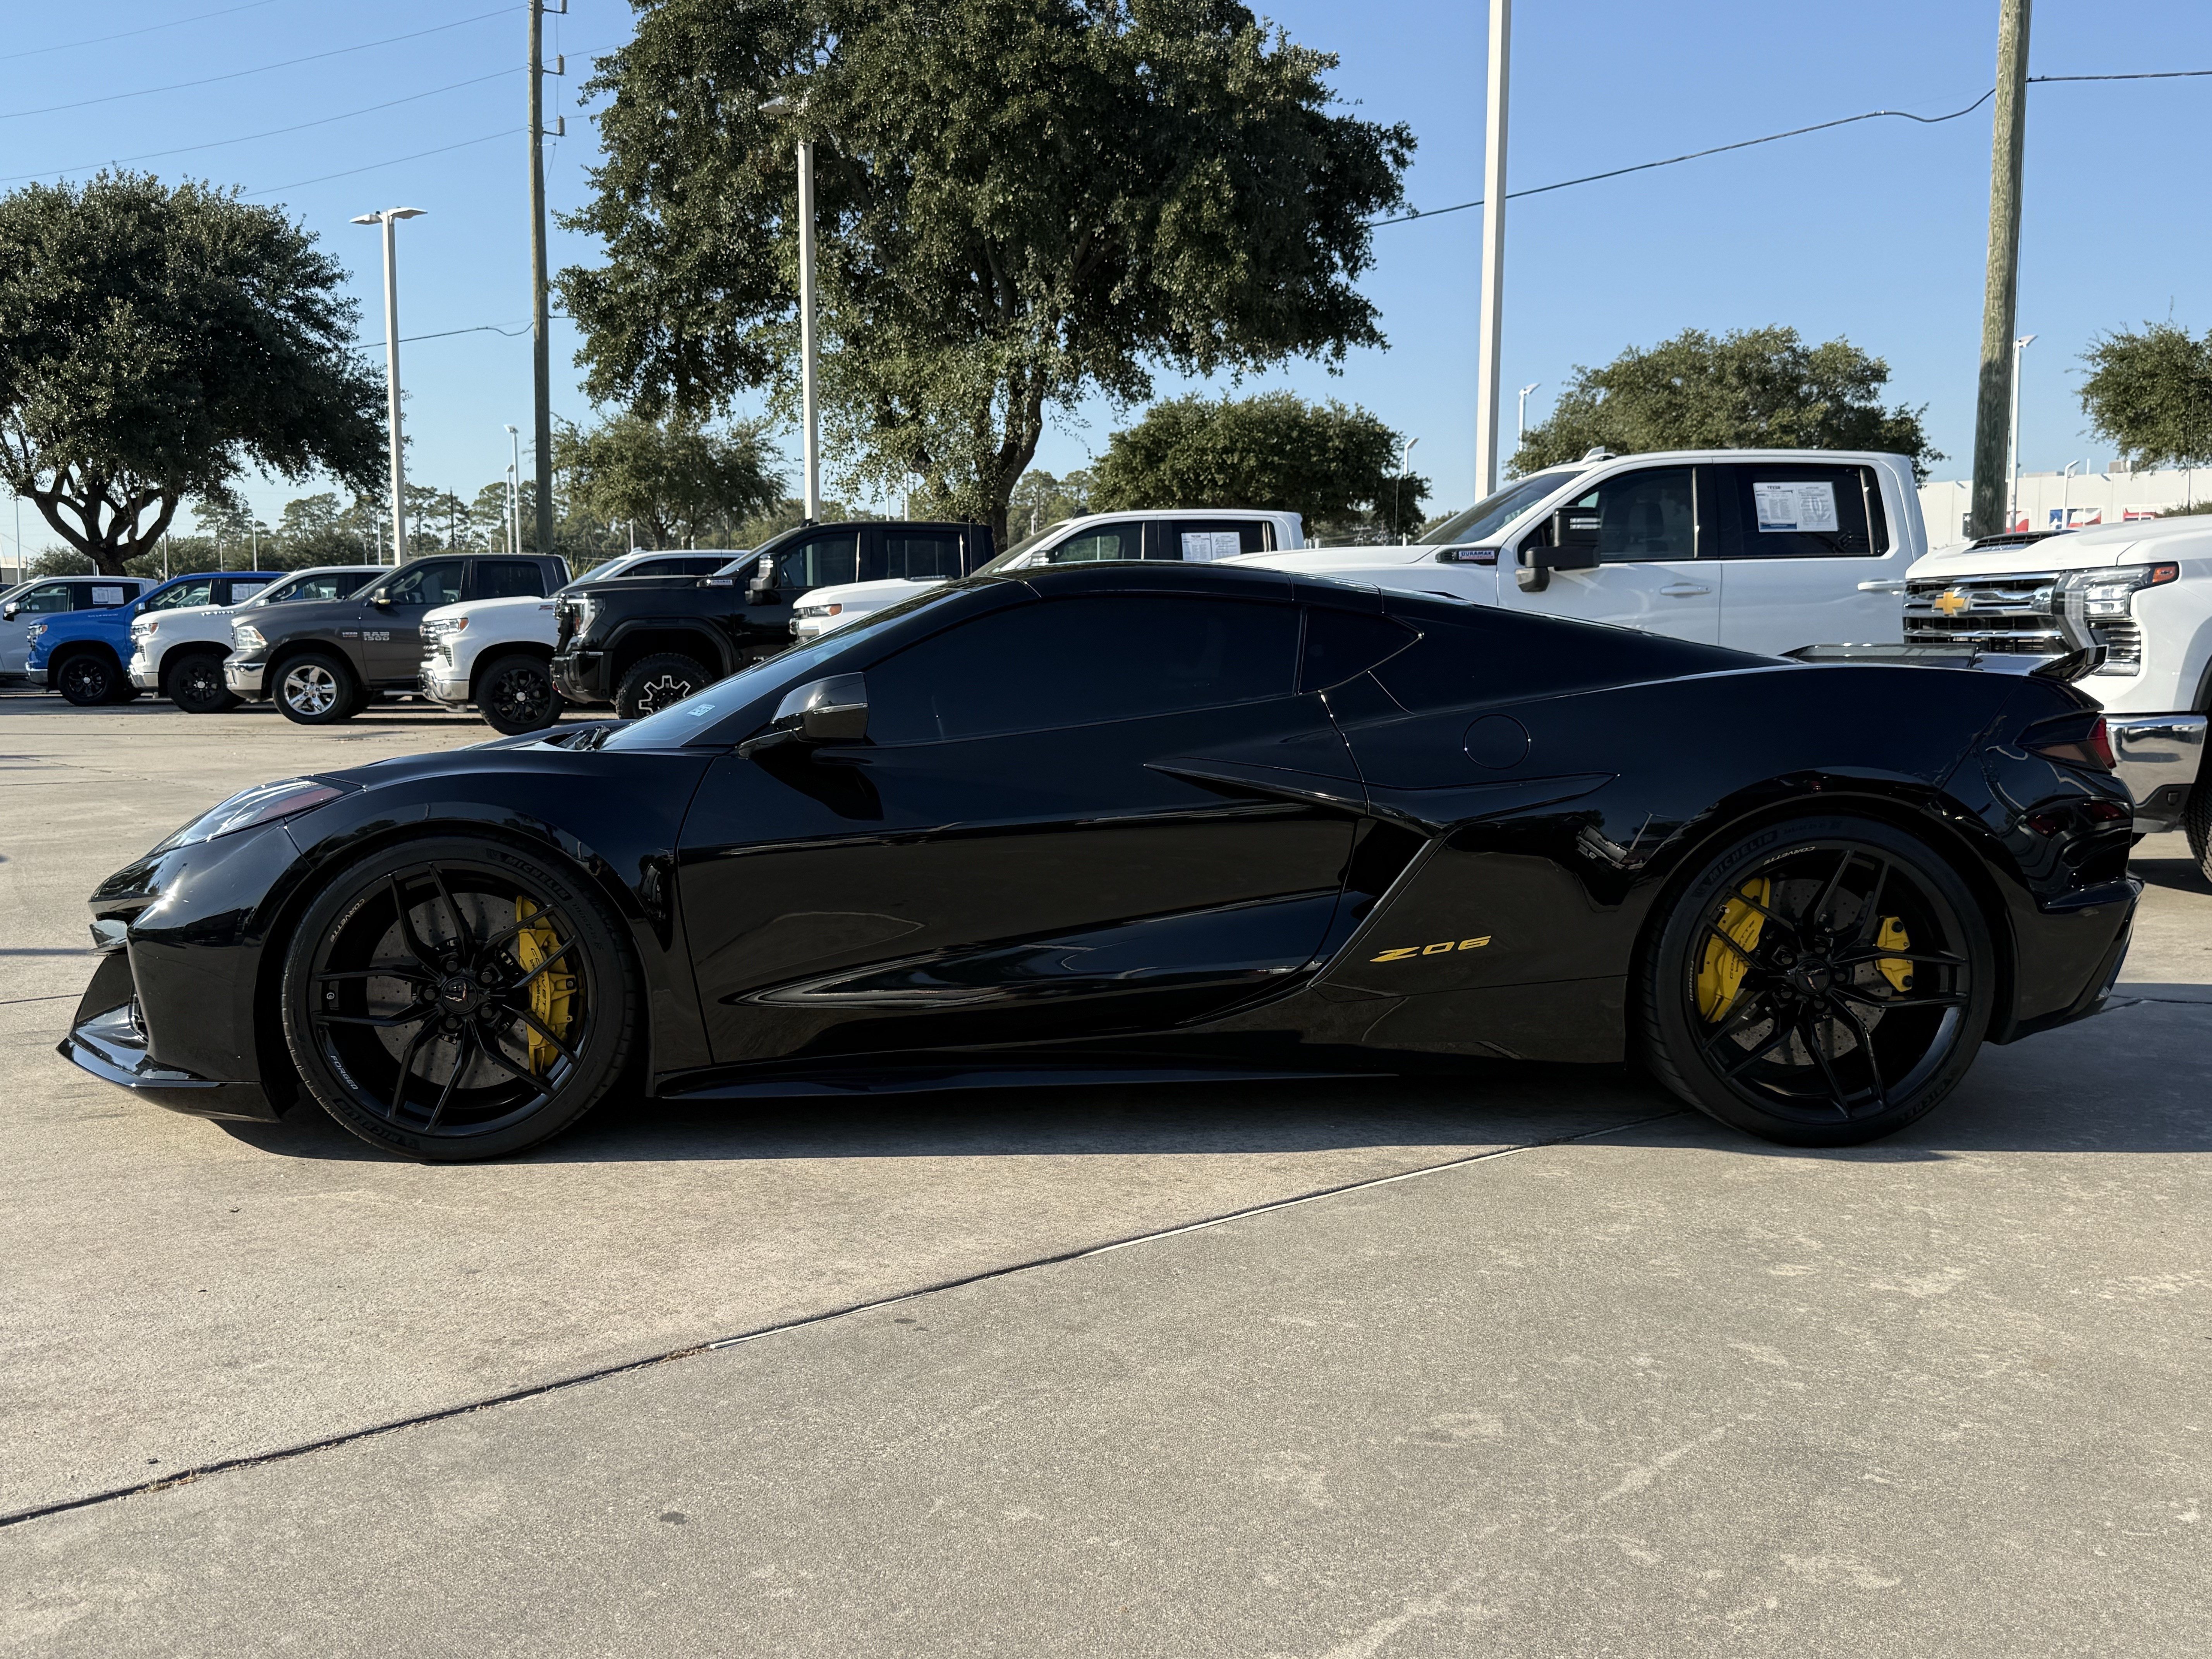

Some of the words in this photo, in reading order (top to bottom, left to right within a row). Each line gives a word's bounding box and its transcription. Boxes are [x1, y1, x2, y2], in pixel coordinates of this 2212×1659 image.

[1763, 846, 1815, 866] CORVETTE
[330, 898, 365, 942] CORVETTE
[1370, 936, 1492, 962] Z06
[330, 1056, 359, 1089] FORGED
